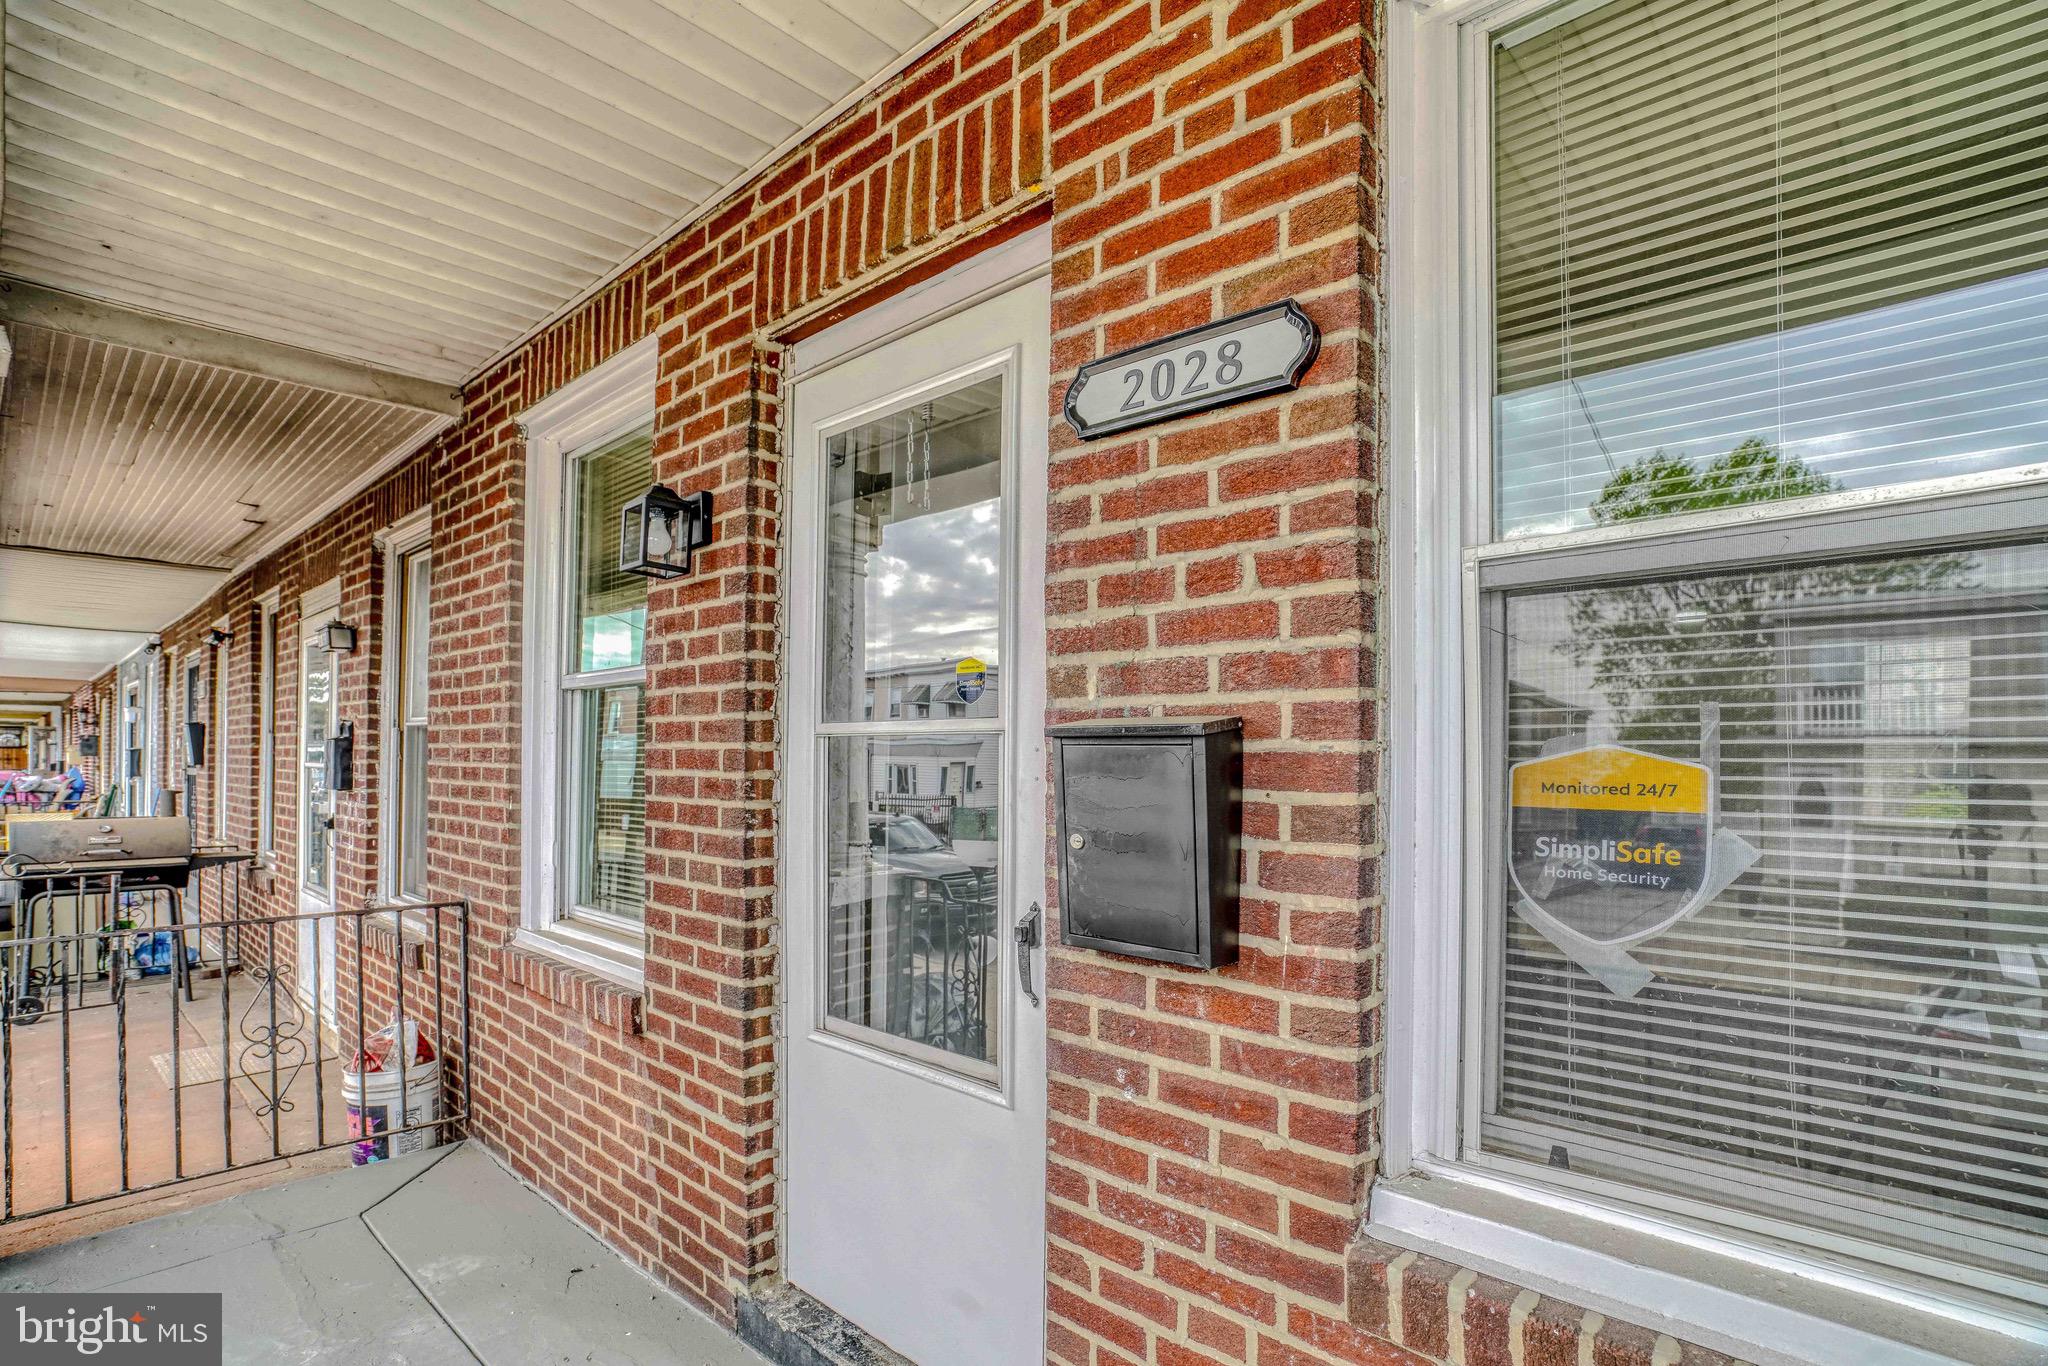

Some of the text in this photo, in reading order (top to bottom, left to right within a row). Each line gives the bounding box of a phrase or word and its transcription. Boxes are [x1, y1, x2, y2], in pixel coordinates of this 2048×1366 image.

[1120, 340, 1243, 412] 2028
[1541, 782, 1678, 797] Monitored 24/7
[1535, 837, 1681, 866] SimpliSafe
[1544, 866, 1670, 889] Home Security
